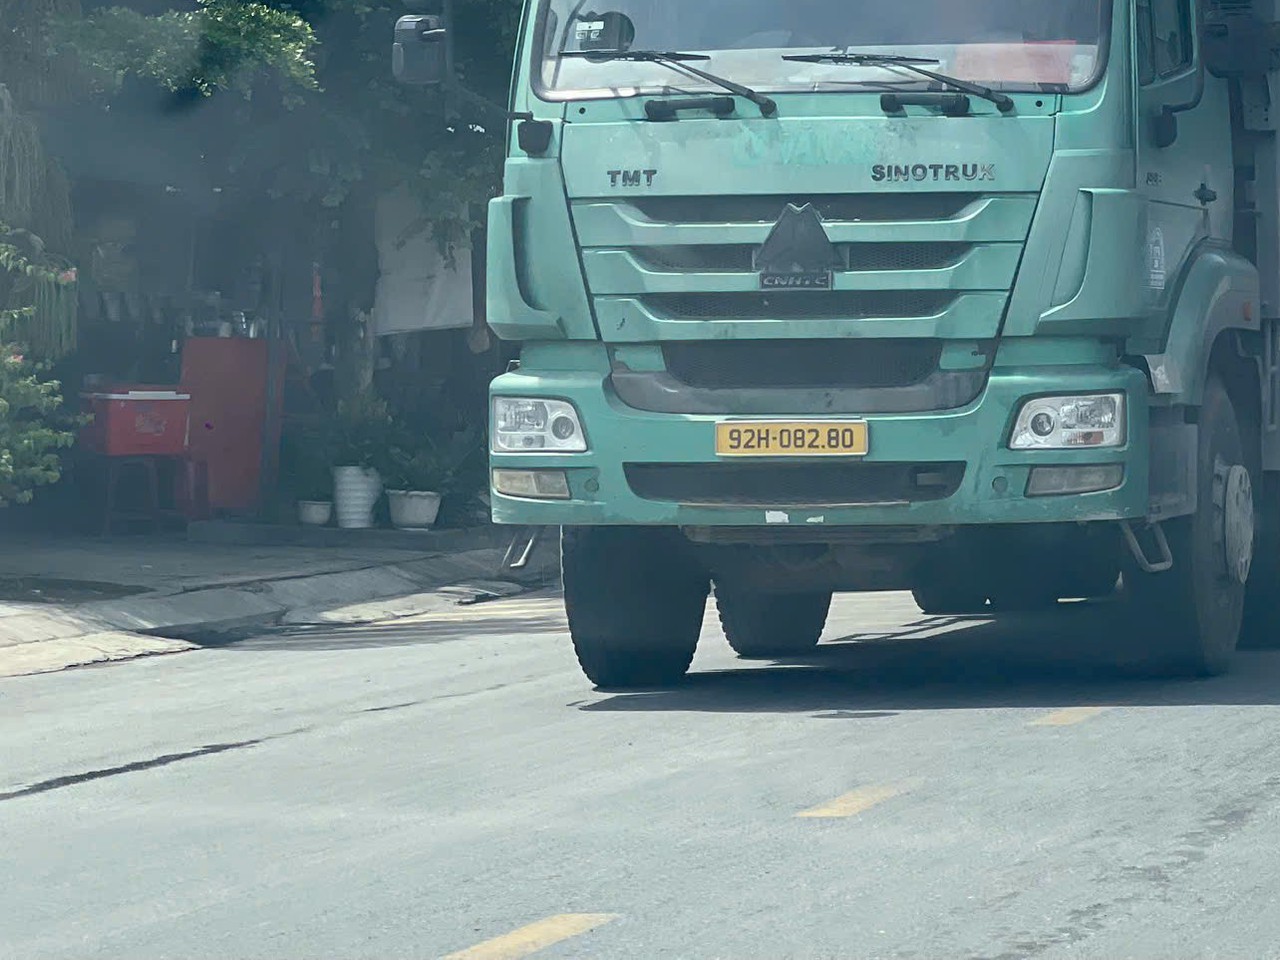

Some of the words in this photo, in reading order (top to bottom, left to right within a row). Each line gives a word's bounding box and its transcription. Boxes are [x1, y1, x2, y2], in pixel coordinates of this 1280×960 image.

[606, 169, 657, 187] TMT
[870, 163, 996, 182] SINOTRUK
[728, 428, 854, 449] 92H-082.80
